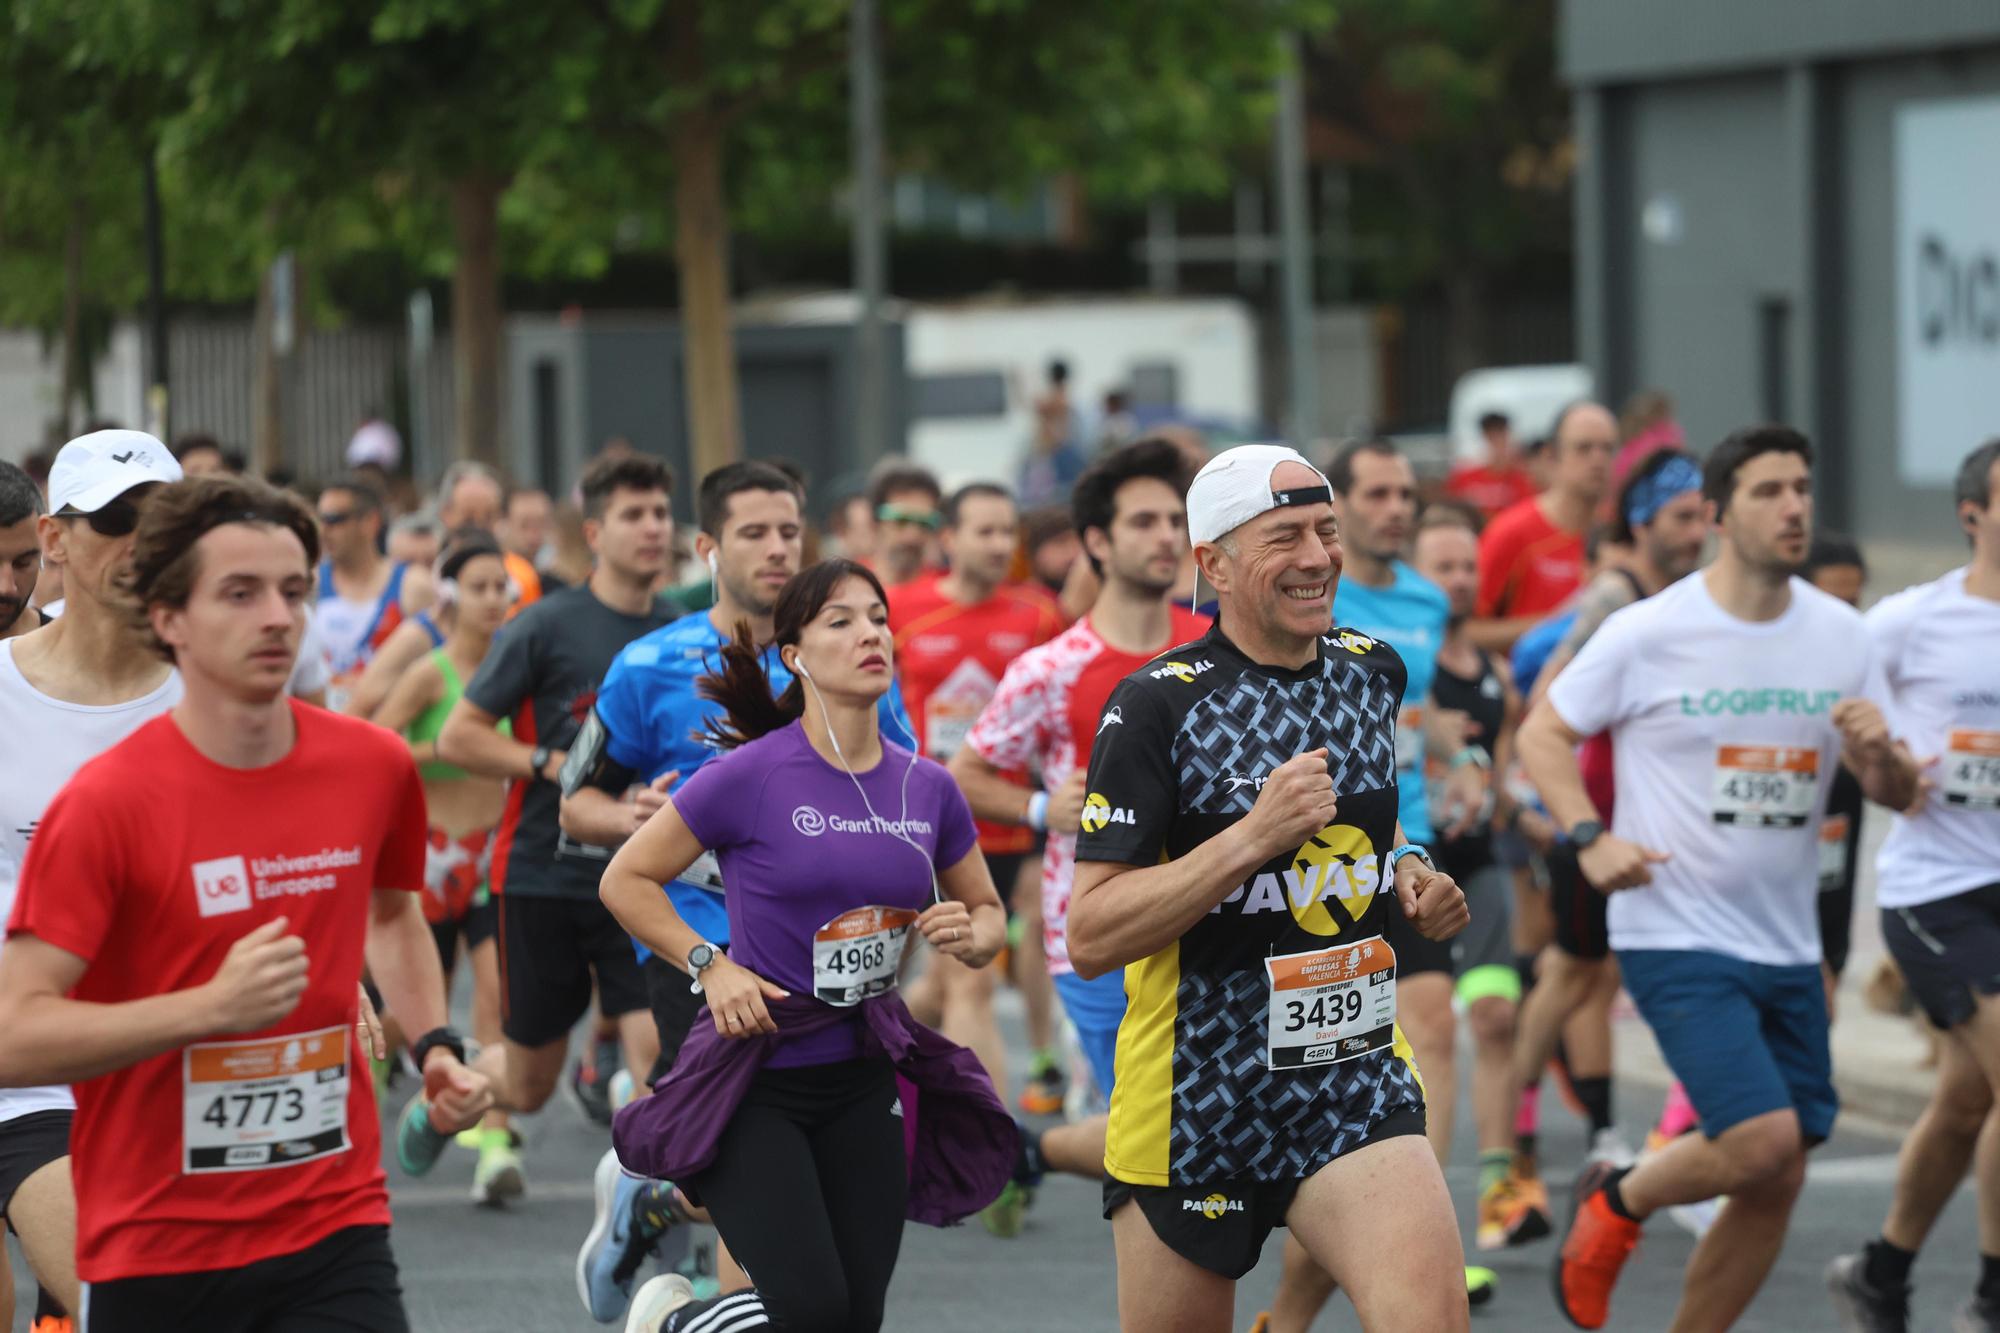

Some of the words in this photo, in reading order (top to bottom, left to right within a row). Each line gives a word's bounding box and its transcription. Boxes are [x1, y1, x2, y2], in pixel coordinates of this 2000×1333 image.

[1721, 777, 1787, 802] 4390
[828, 814, 872, 834] Grant
[871, 816, 932, 834] Thornton
[251, 846, 361, 877] Universidad
[203, 874, 240, 898] ue
[255, 873, 337, 900] Europea
[827, 942, 884, 975] 4968
[1301, 961, 1340, 975] EMPRESAS
[1308, 969, 1341, 982] VALENCIA
[1372, 968, 1389, 984] 10K
[1285, 990, 1362, 1032] 3439
[1315, 1029, 1339, 1040] David
[1307, 1048, 1333, 1058] 42K
[203, 1087, 304, 1129] 4773
[1182, 1199, 1245, 1212] PAVASAL
